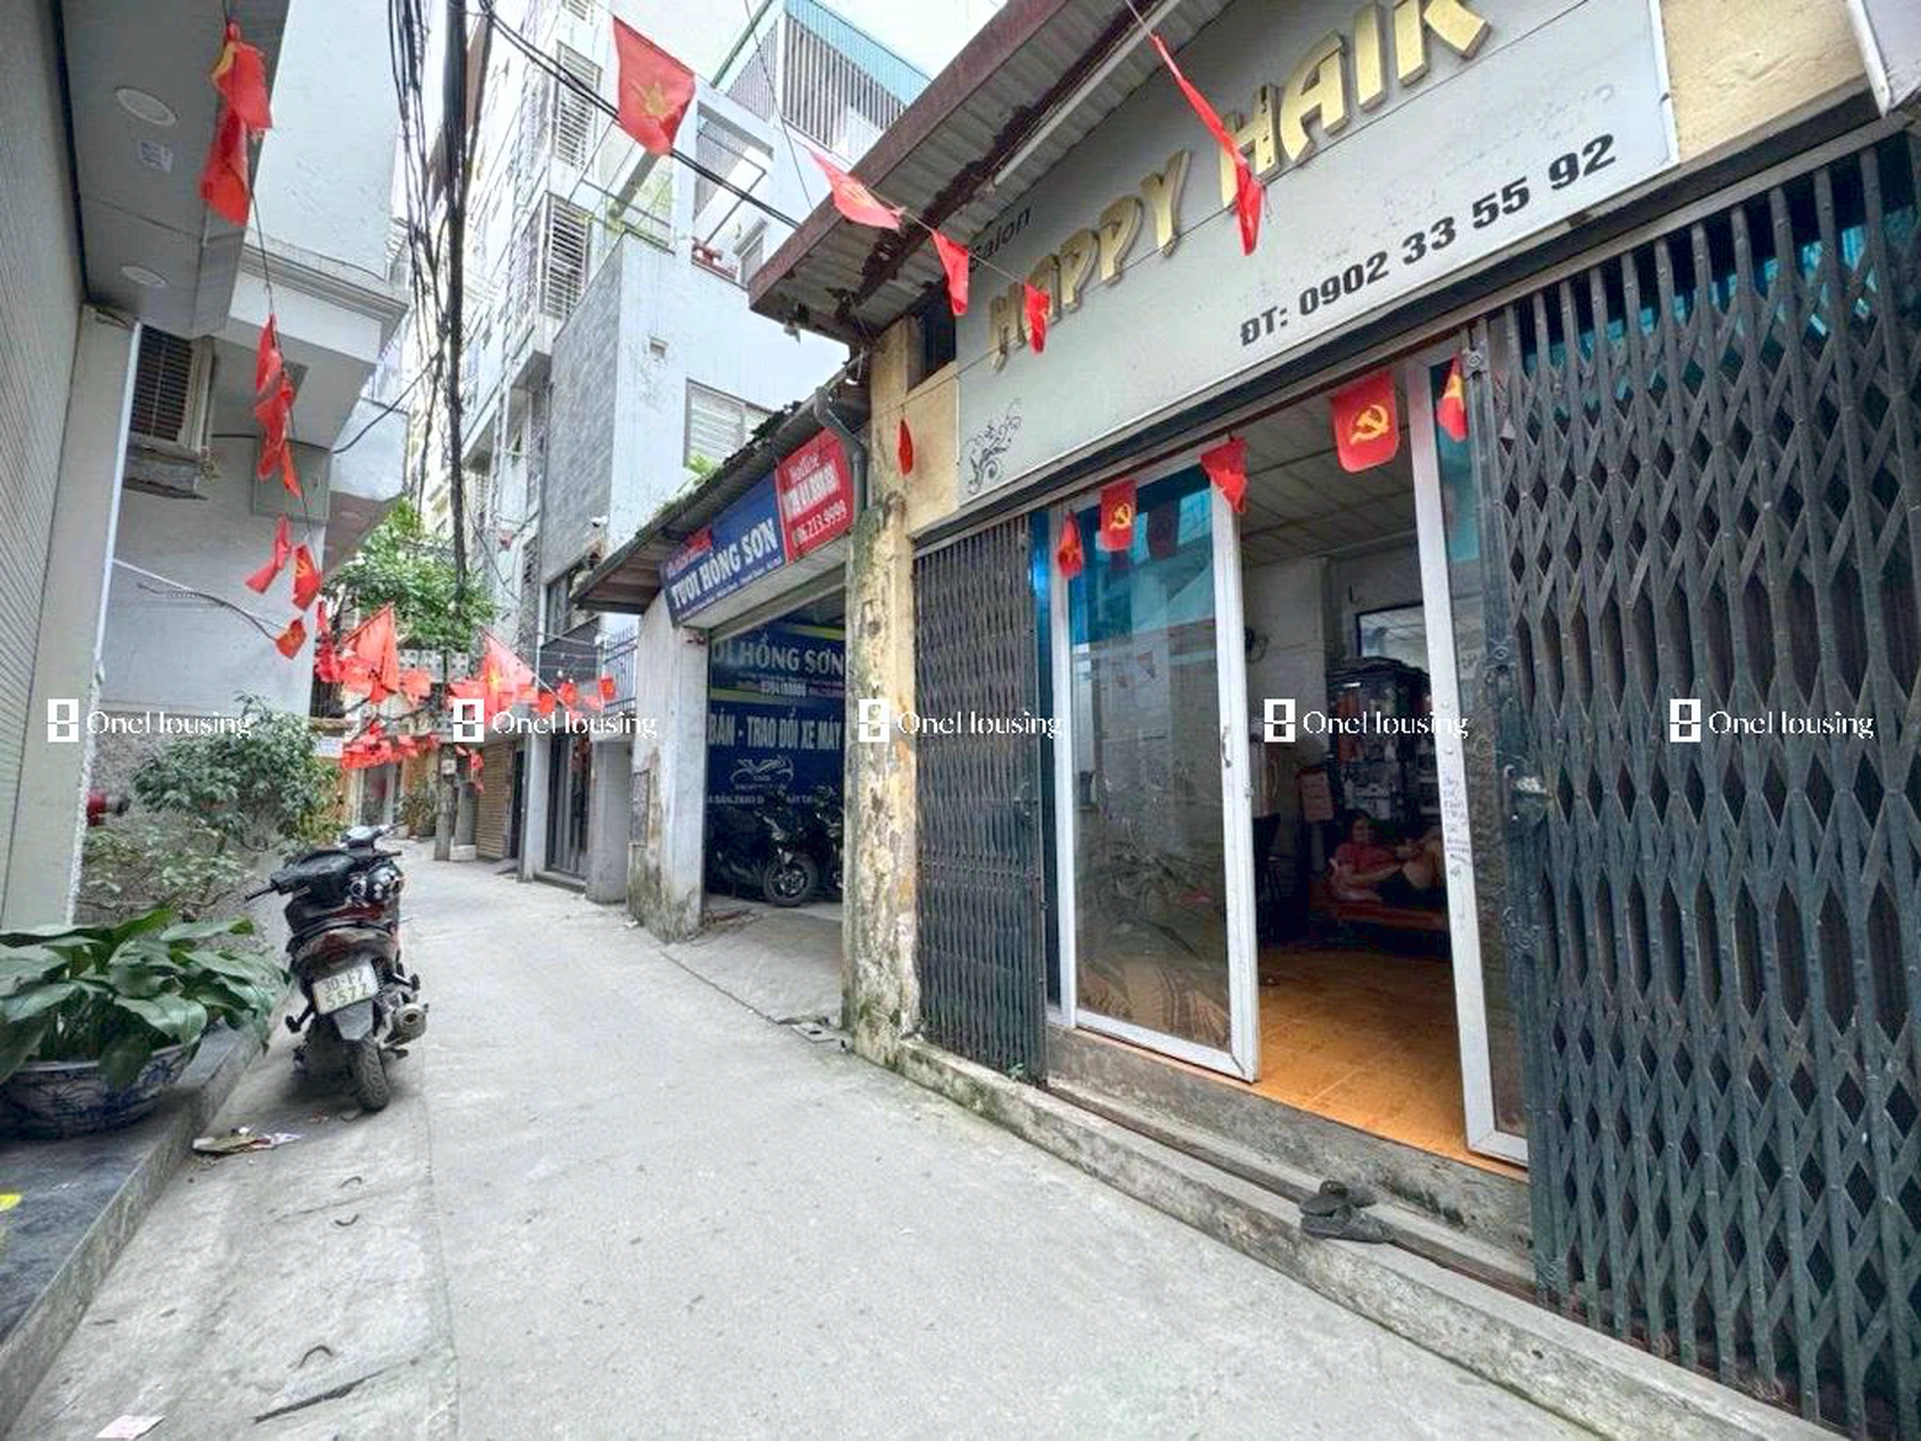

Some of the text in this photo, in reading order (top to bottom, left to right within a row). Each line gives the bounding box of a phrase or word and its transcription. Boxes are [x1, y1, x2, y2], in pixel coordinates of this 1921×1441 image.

[1240, 133, 1616, 347] ĐT: 0902 33 55 92
